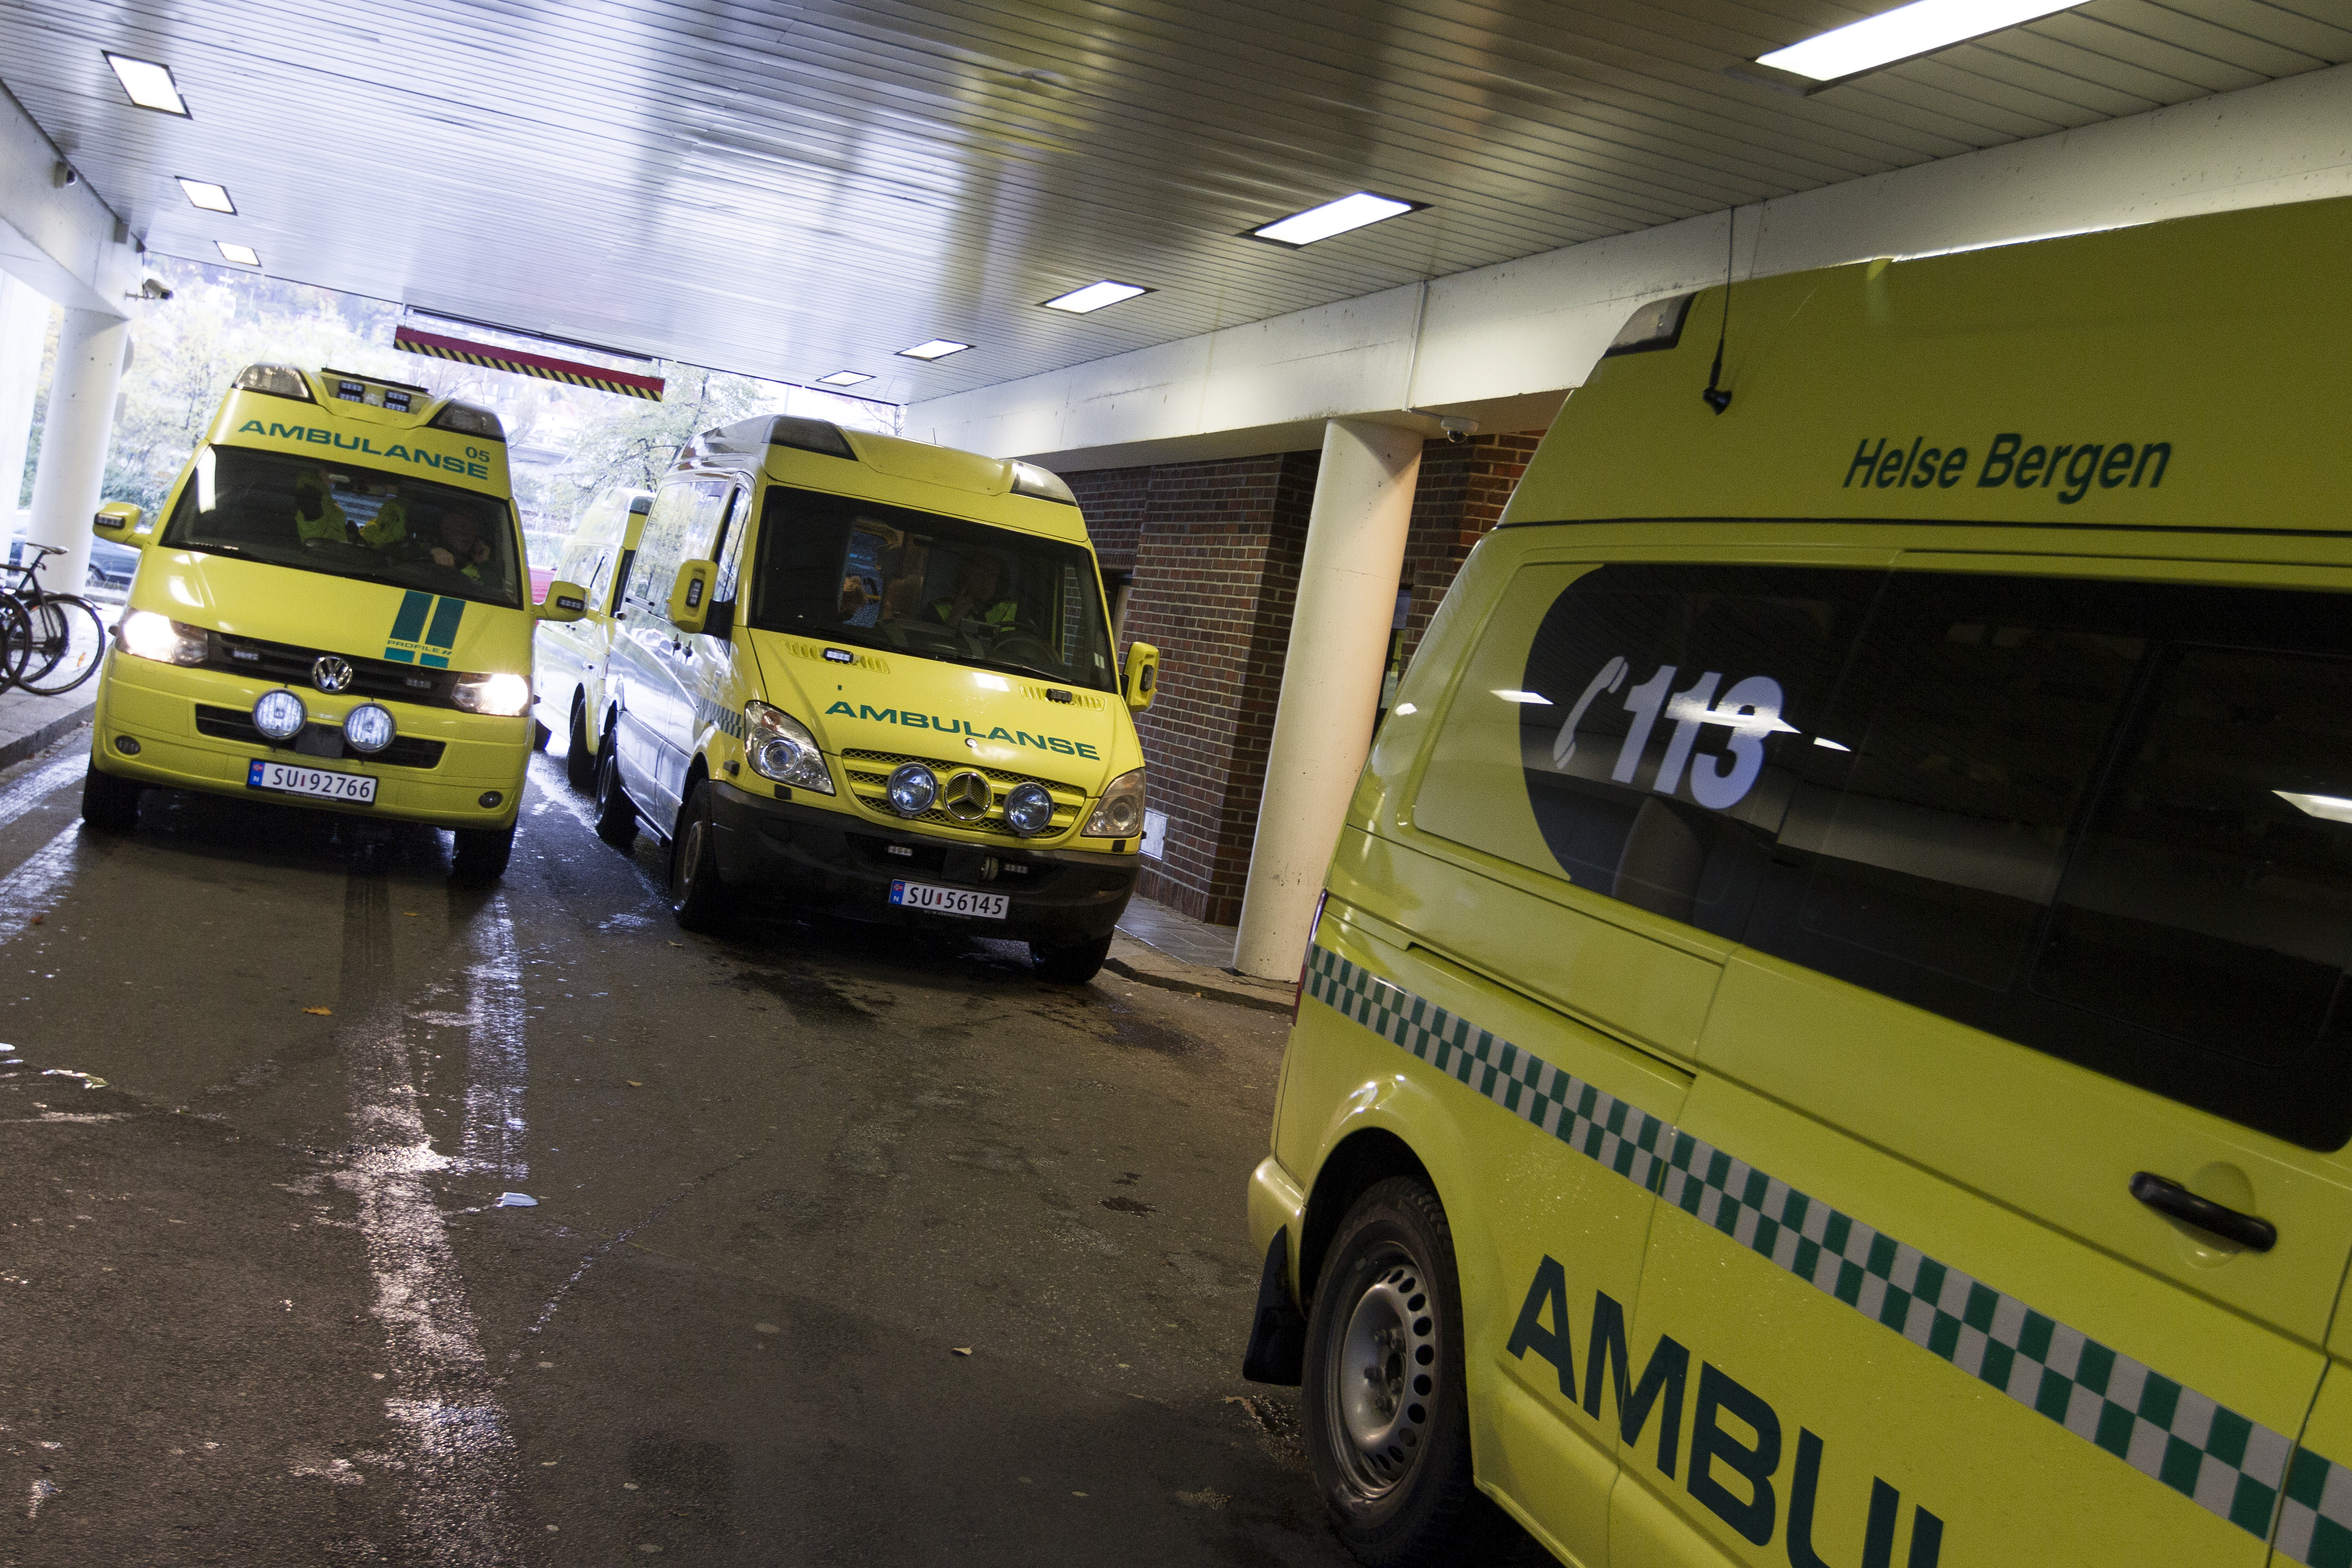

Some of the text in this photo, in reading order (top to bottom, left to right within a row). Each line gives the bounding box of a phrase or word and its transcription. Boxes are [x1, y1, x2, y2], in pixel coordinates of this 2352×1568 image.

[238, 420, 489, 480] AMBULANSE
[465, 446, 491, 463] 05
[1843, 433, 2172, 504] Helse Bergen
[387, 640, 440, 653] PROFILE
[825, 701, 1101, 762] AMBULANSE
[1611, 665, 1784, 810] 113
